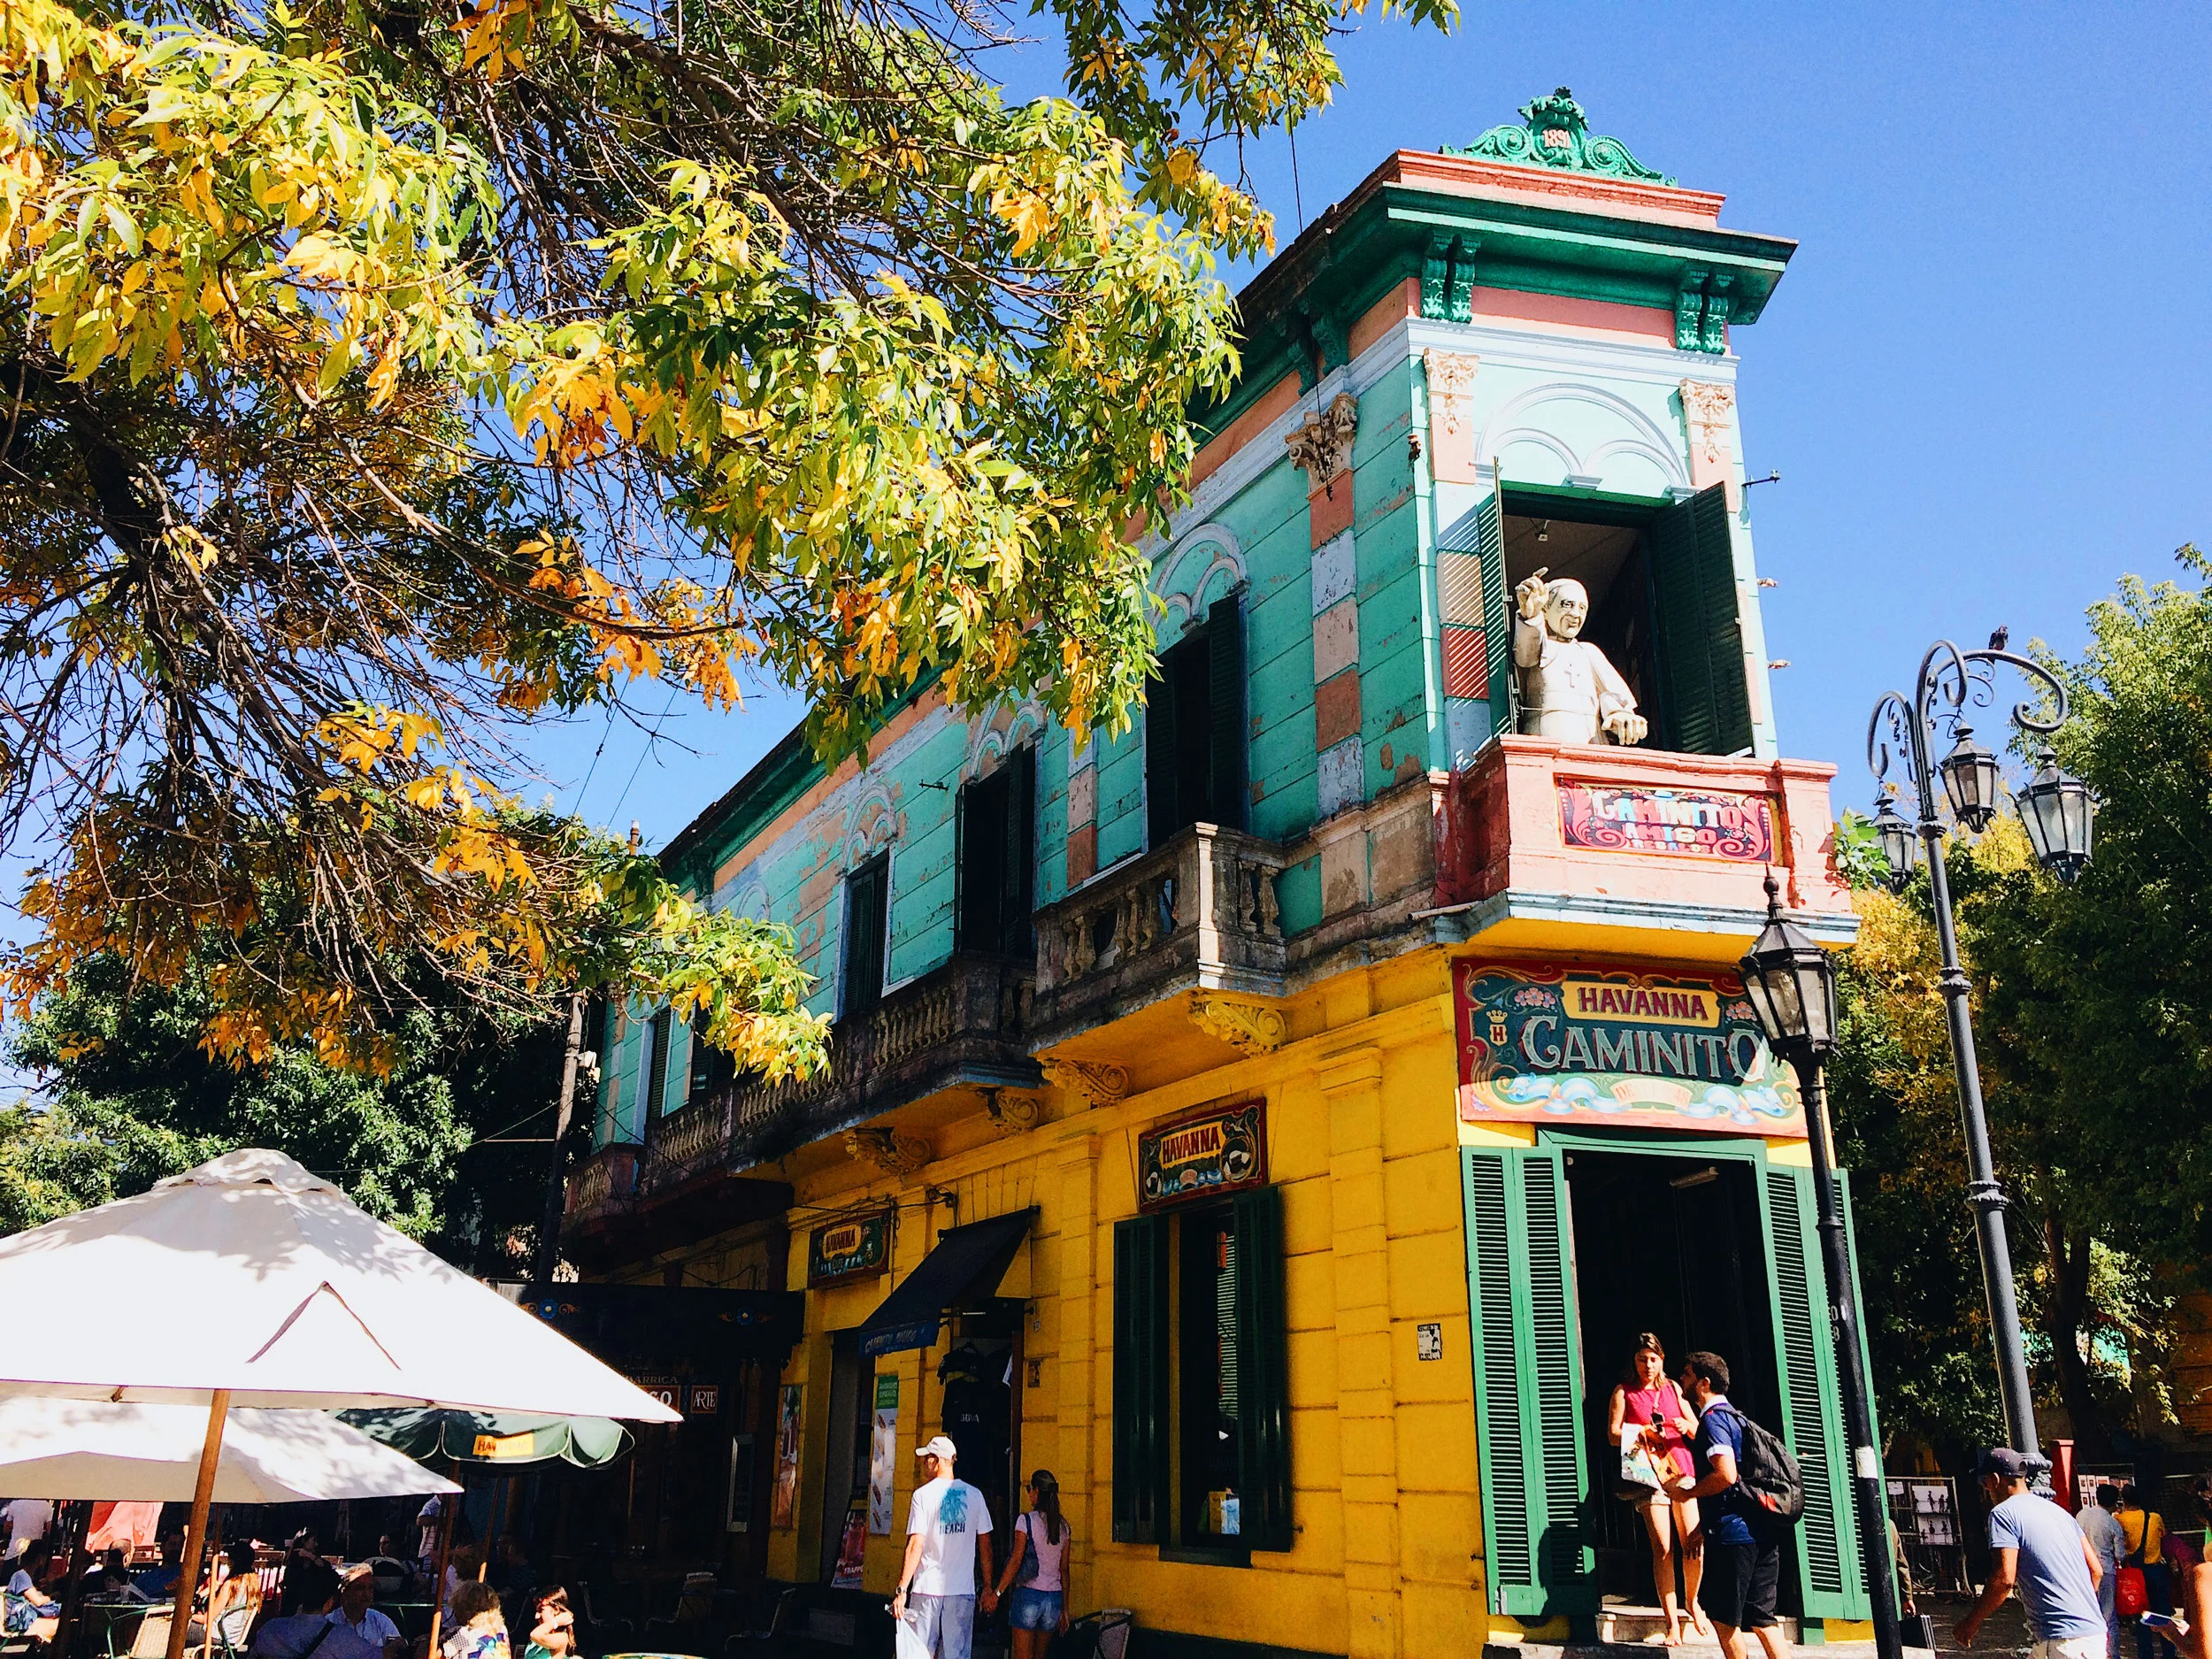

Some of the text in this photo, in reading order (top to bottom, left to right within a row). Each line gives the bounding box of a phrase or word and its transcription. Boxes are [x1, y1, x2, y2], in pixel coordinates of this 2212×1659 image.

[1542, 129, 1571, 149] 1891
[1592, 791, 1742, 830] CAMINITO
[1578, 987, 1709, 1020] HAVANNA
[1493, 1026, 1504, 1041] H
[1518, 1015, 1768, 1083] CAMINITO
[1163, 1125, 1221, 1164] HAVANNA
[693, 1390, 716, 1410] ARTE
